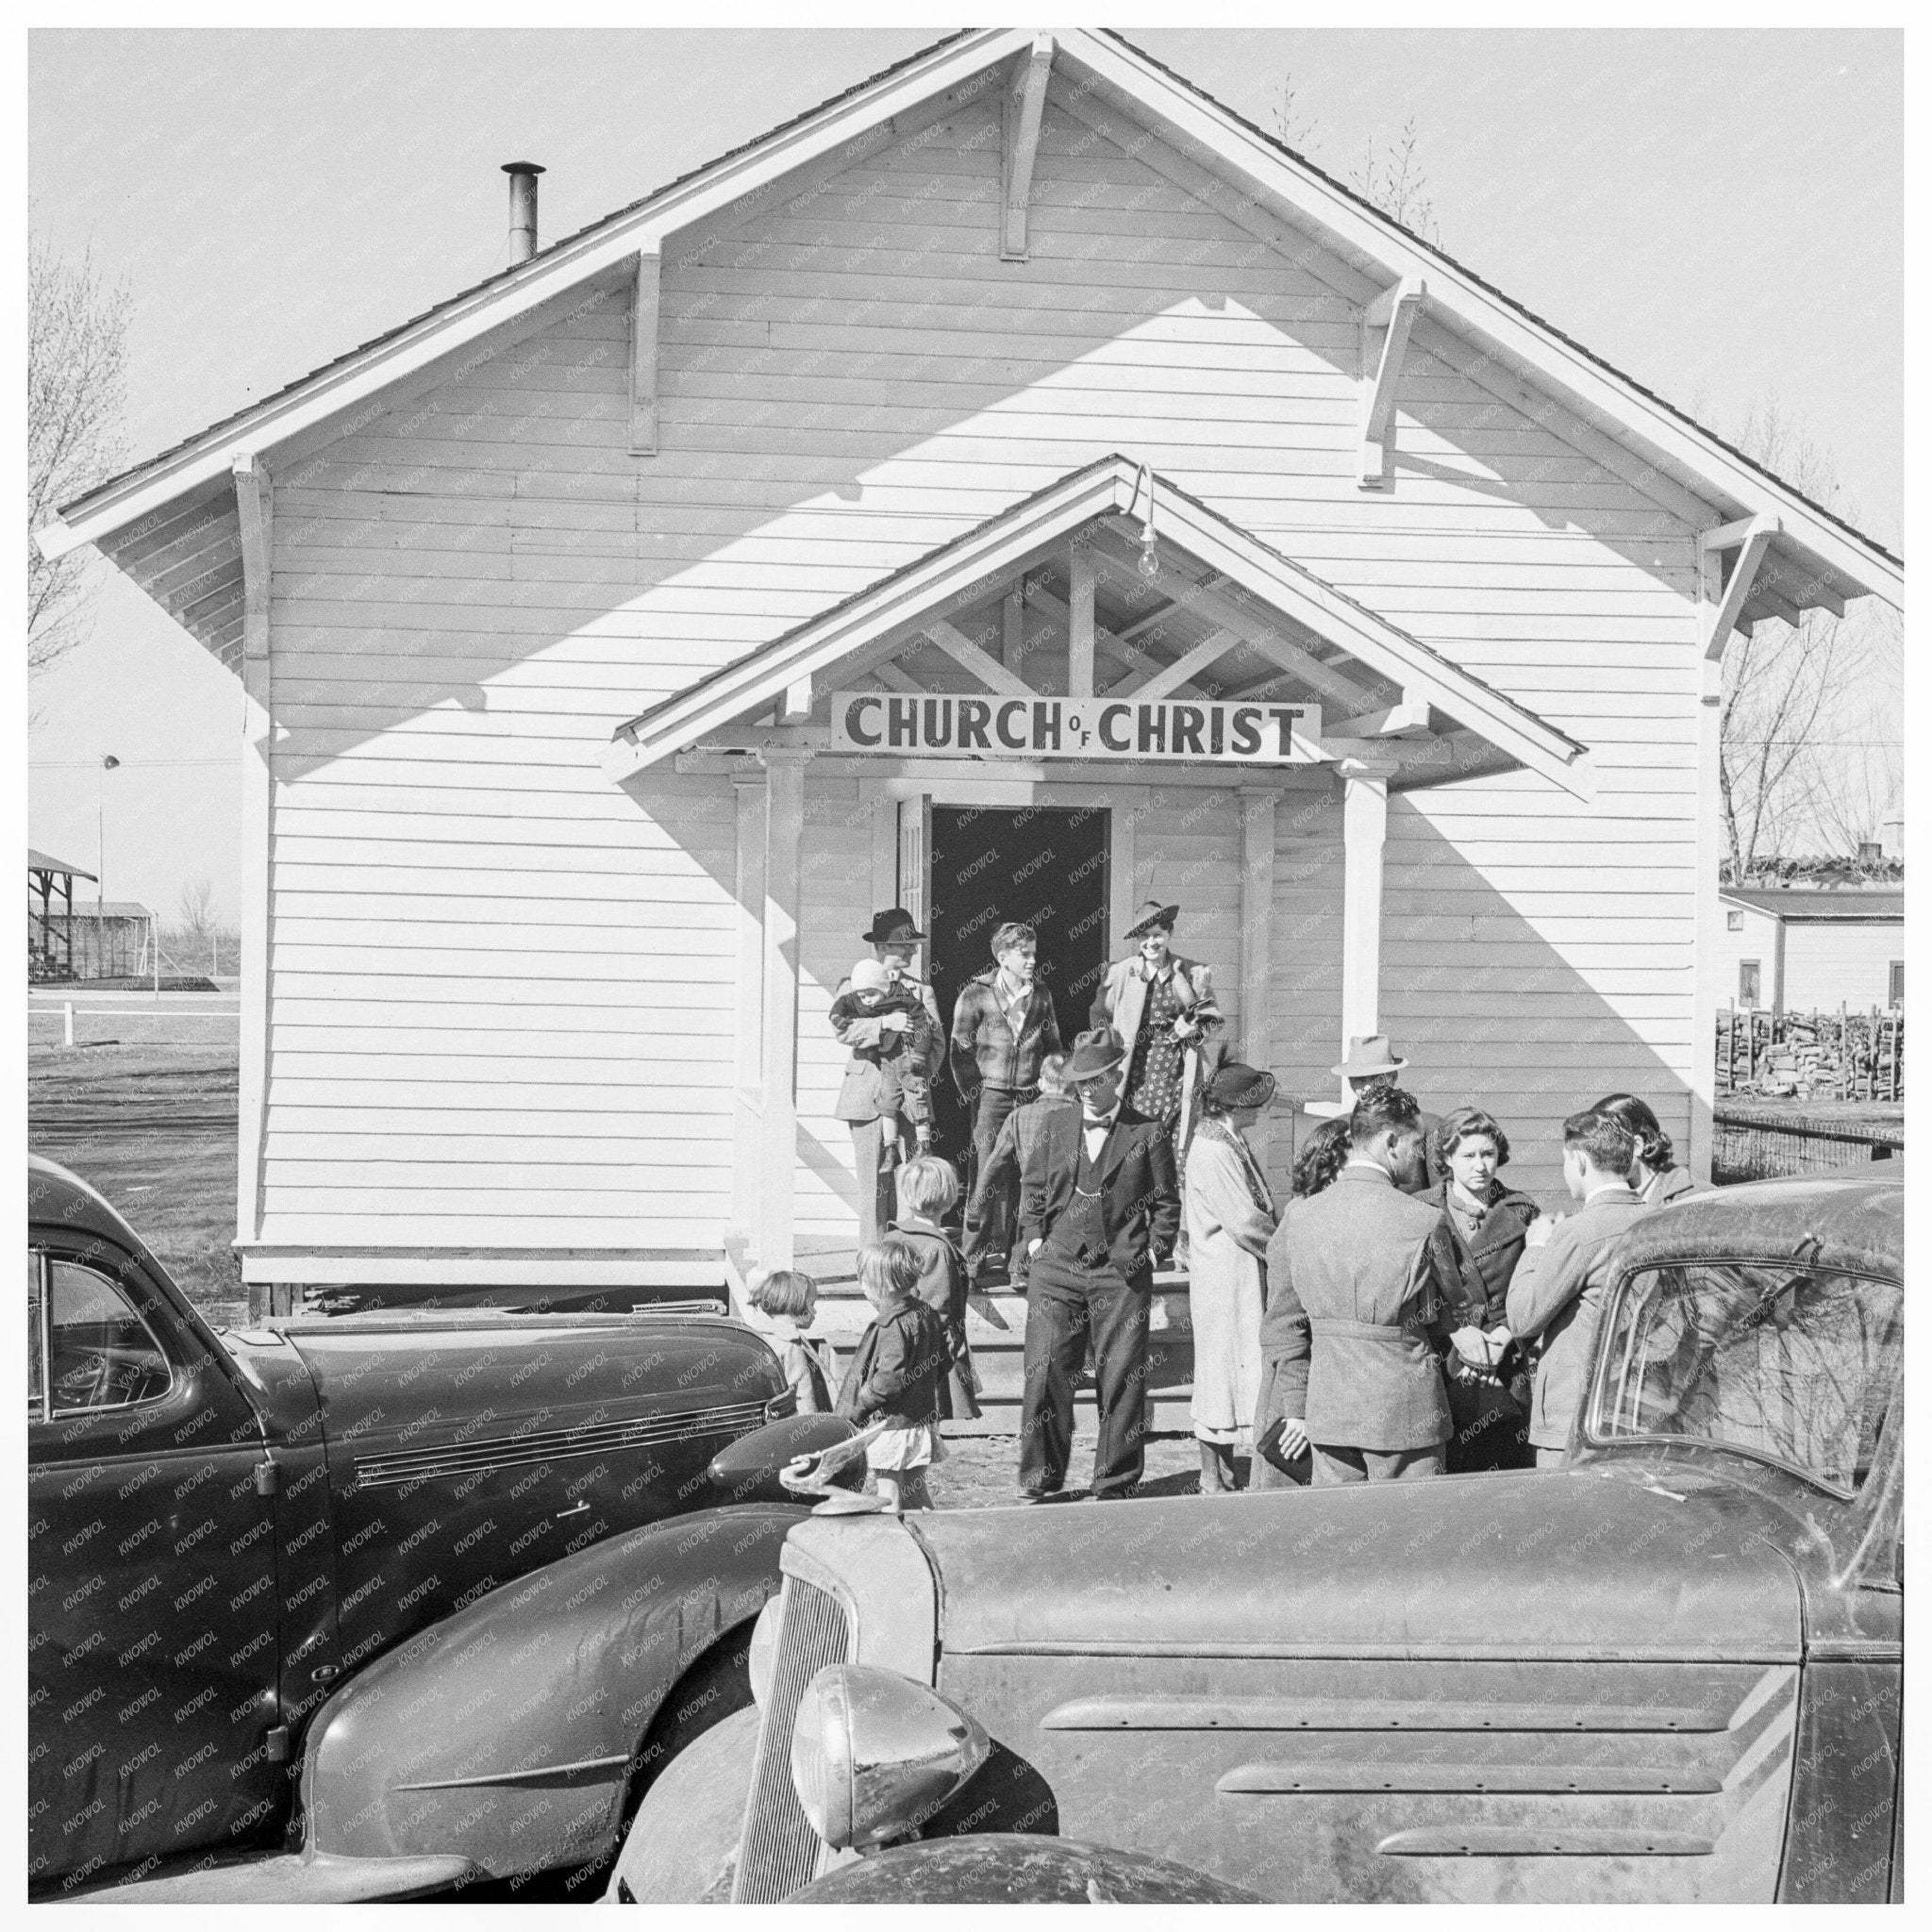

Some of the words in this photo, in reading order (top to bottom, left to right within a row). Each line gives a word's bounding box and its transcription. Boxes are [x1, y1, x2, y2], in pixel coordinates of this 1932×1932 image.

[845, 697, 1060, 751] CHURCH
[1069, 715, 1091, 746] OF
[1098, 704, 1304, 756] CHRIST
